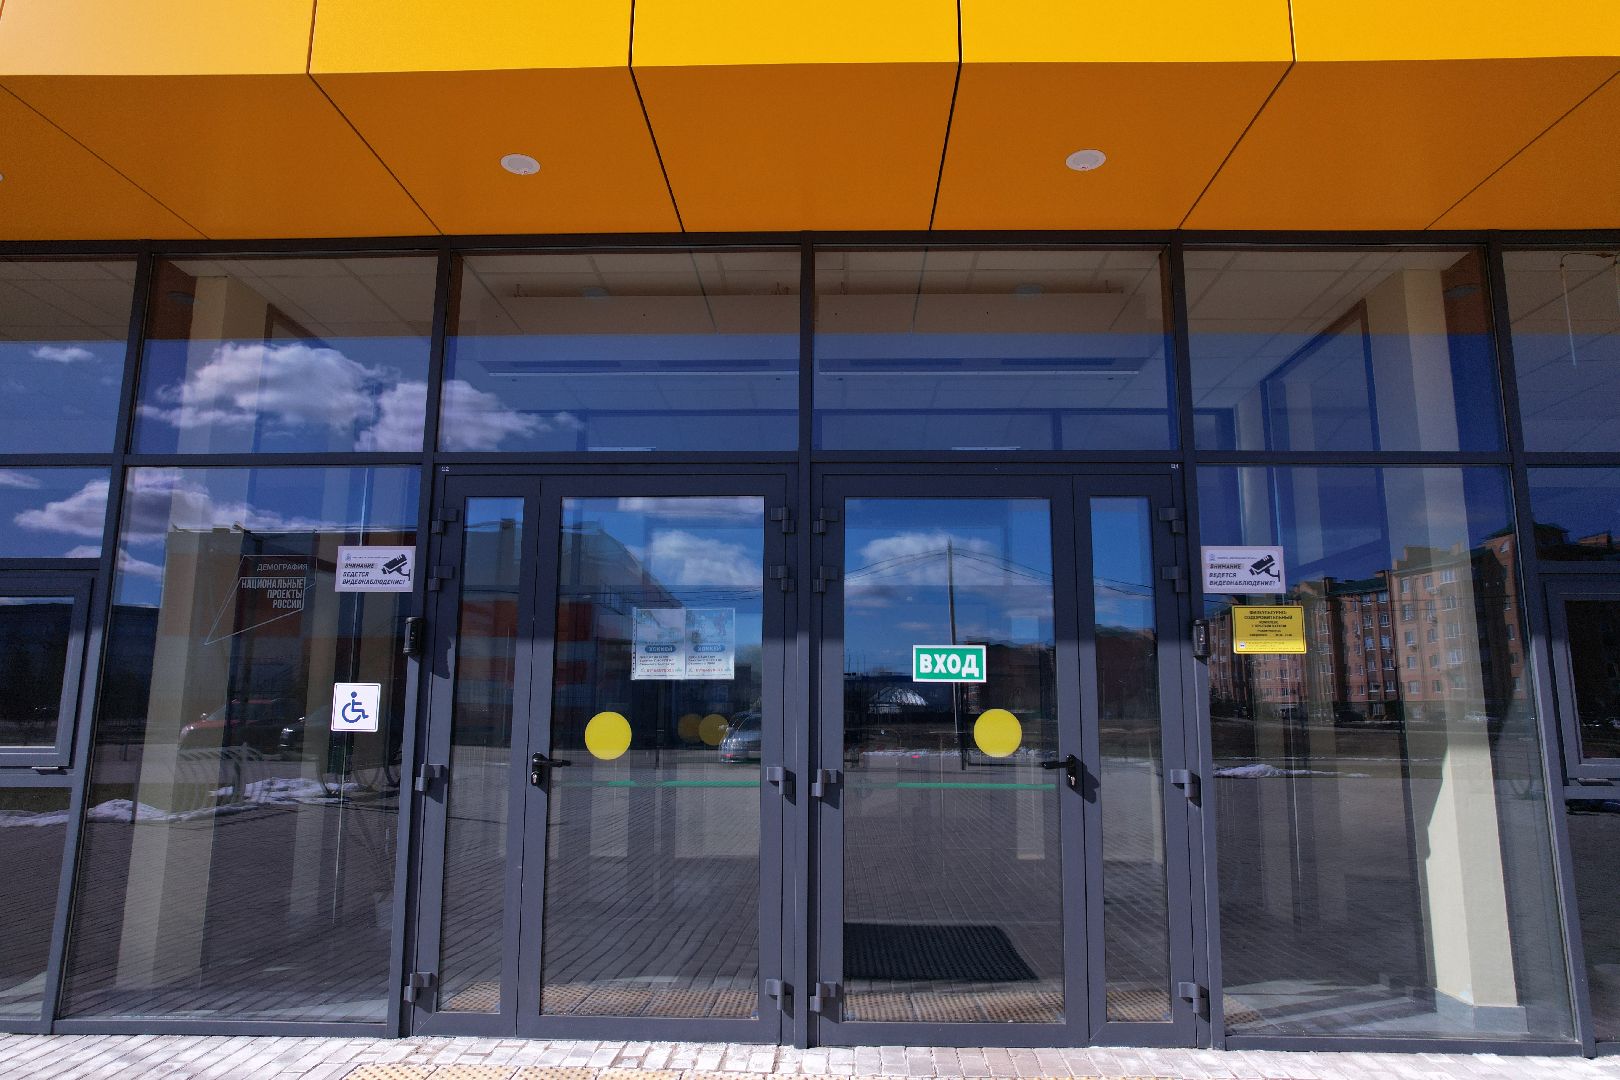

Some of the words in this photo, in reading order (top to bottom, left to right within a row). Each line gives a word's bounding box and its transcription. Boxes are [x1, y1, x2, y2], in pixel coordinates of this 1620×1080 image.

[256, 563, 308, 572] ДЕМОГРАФИЯ
[241, 578, 304, 590] НАЦИОНАЛЬНЫЕ
[267, 589, 303, 599] ПРОЕКТЫ
[272, 599, 302, 609] РОССИИ
[919, 653, 980, 678] ВХОД
